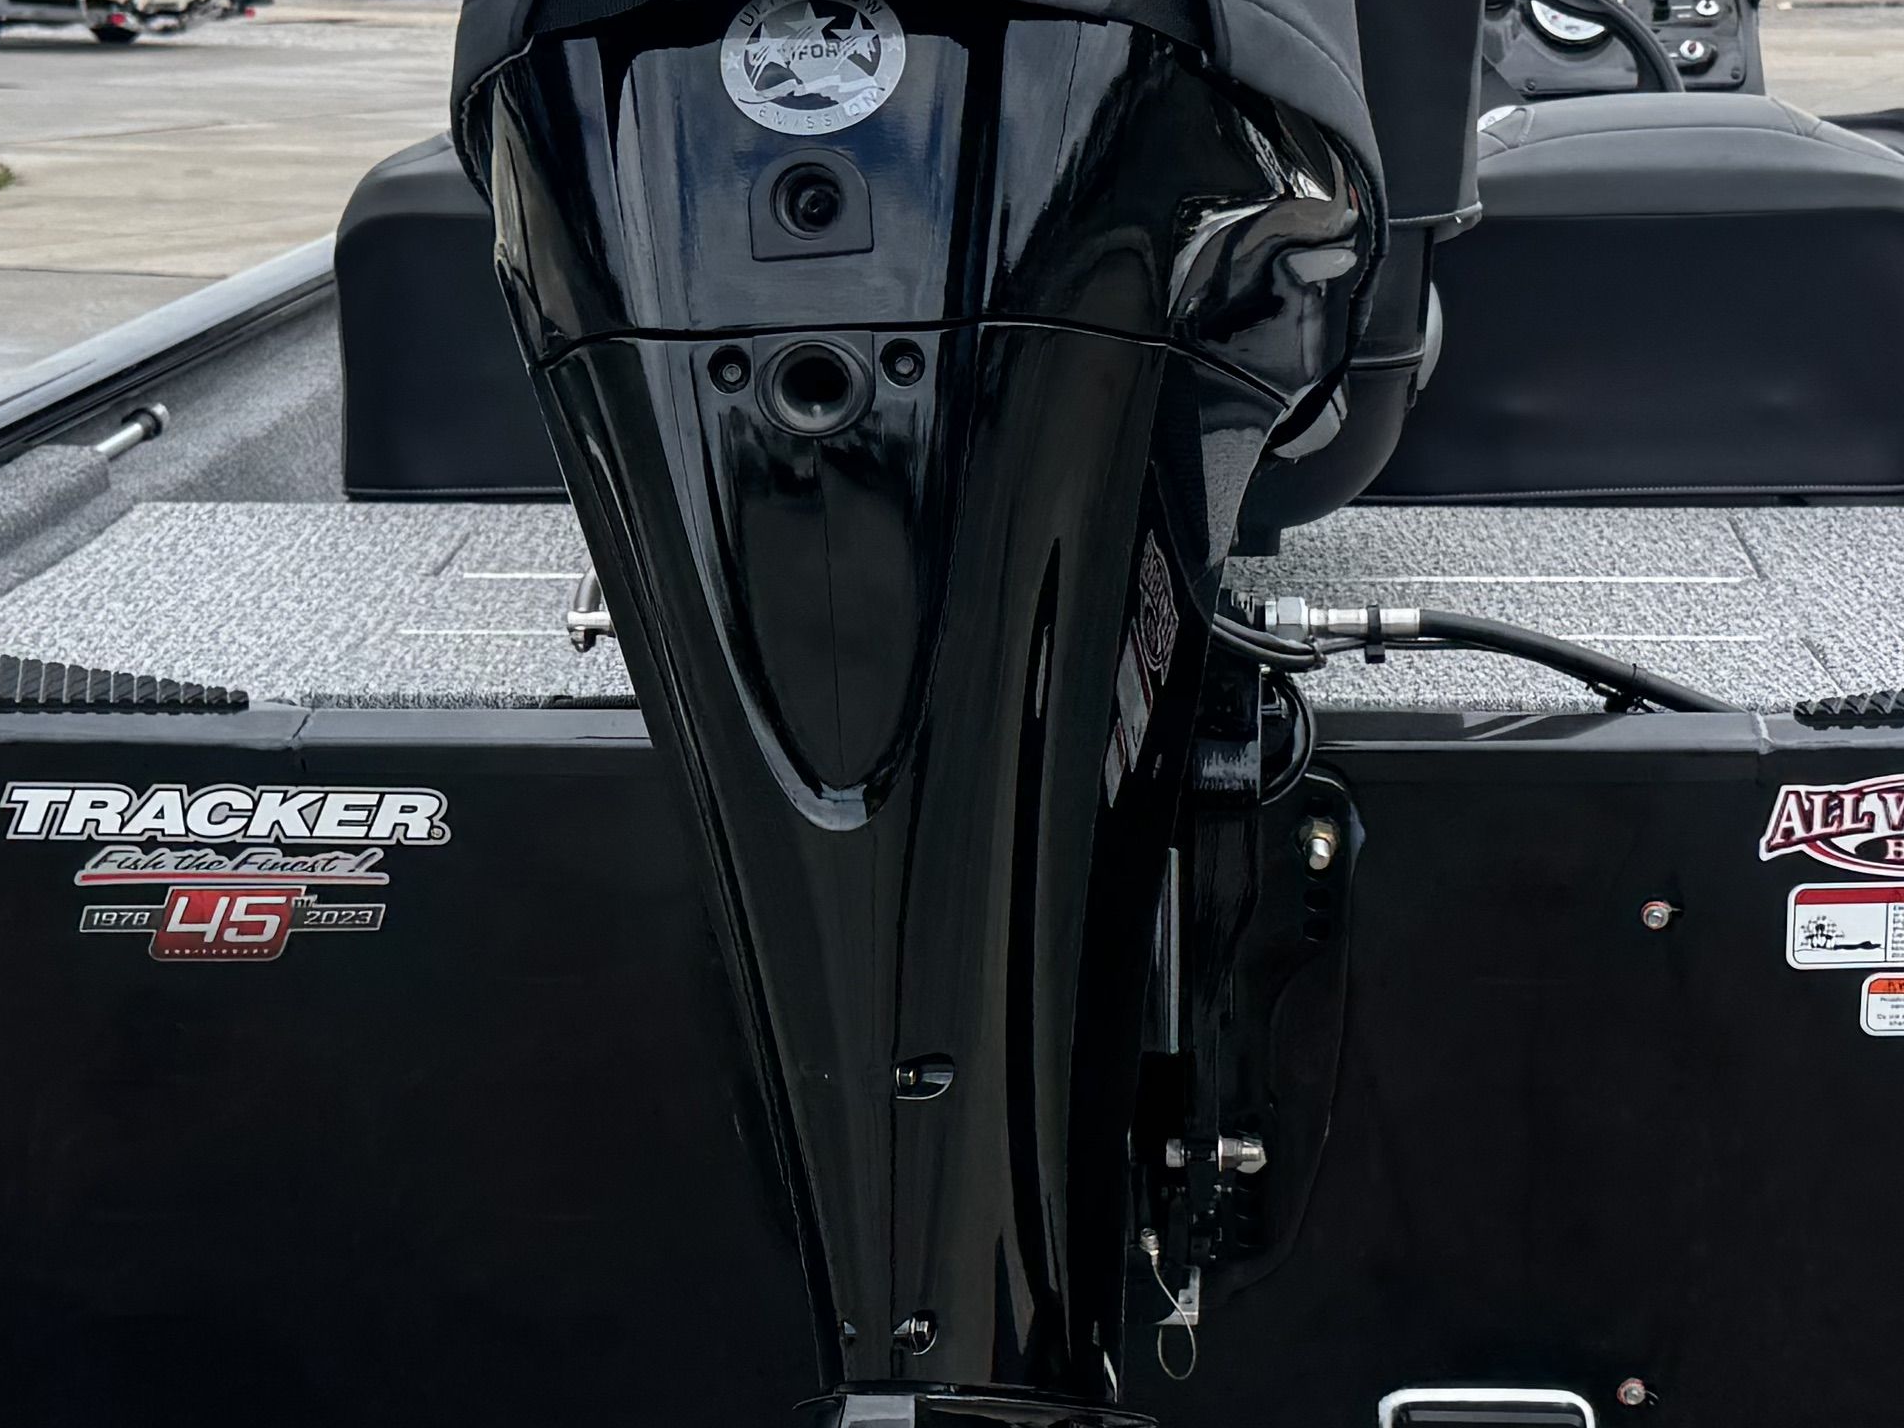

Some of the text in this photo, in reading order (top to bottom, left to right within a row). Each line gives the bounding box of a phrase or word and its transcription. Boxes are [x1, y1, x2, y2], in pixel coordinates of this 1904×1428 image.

[4, 788, 443, 839] TRACKER
[1768, 789, 1874, 848] ALL
[90, 849, 166, 872] Fish
[173, 853, 228, 872] the
[92, 911, 152, 927] 1978
[303, 909, 374, 925] 2023
